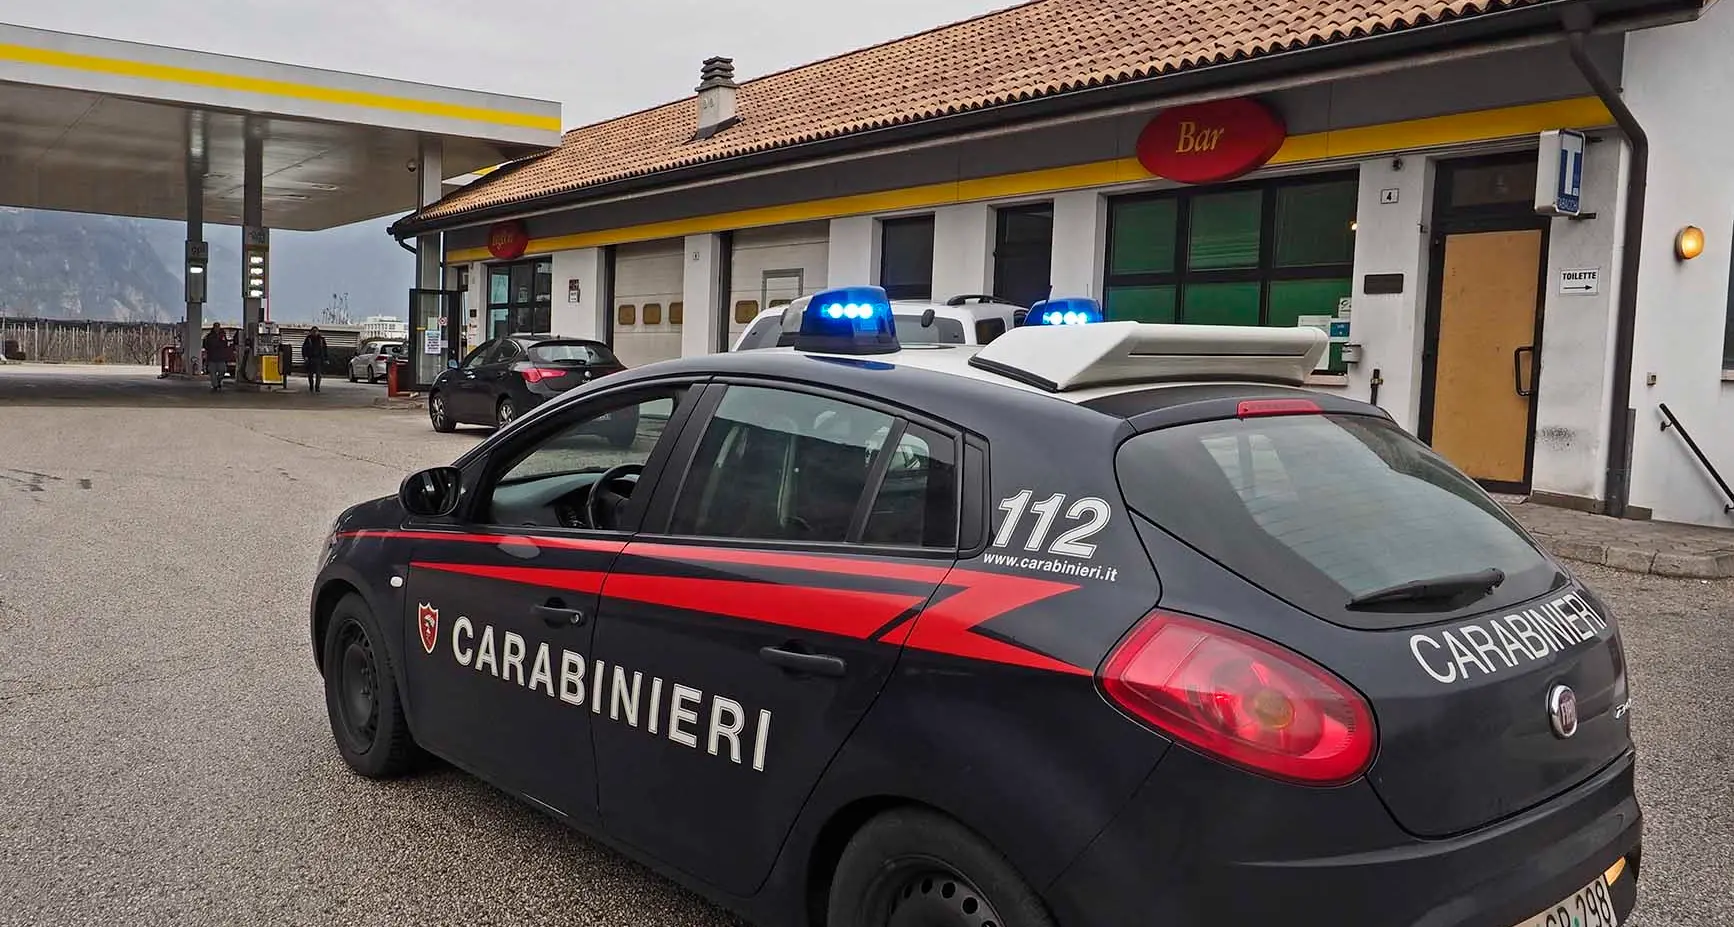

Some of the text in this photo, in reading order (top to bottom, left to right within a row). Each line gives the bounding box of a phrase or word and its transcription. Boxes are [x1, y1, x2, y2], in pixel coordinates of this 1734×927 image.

[1176, 121, 1225, 153] Bar
[1562, 271, 1597, 281] TOILETTE
[992, 489, 1112, 559] 112
[983, 552, 1118, 582] www.carabinieri.it
[1409, 591, 1608, 683] CARABINIERI
[452, 615, 772, 772] CARABINIERI
